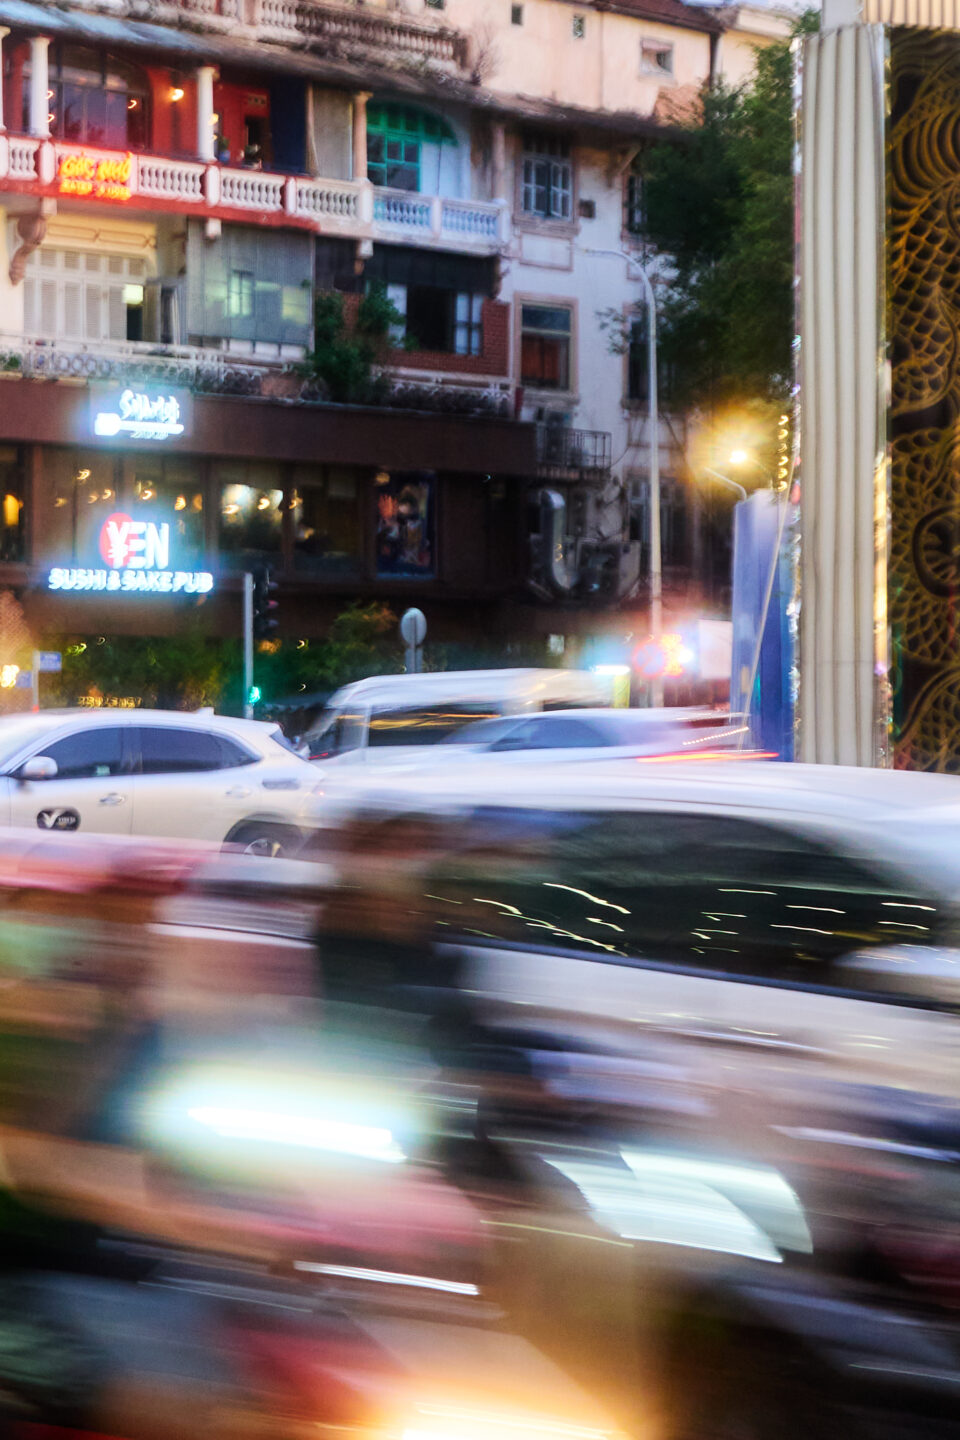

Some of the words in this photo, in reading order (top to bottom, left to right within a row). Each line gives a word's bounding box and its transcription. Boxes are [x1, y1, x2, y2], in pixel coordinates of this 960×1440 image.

[48, 568, 107, 590] SUSHI
[106, 570, 121, 590] &
[121, 570, 173, 592] SAKE
[172, 572, 213, 593] PUB
